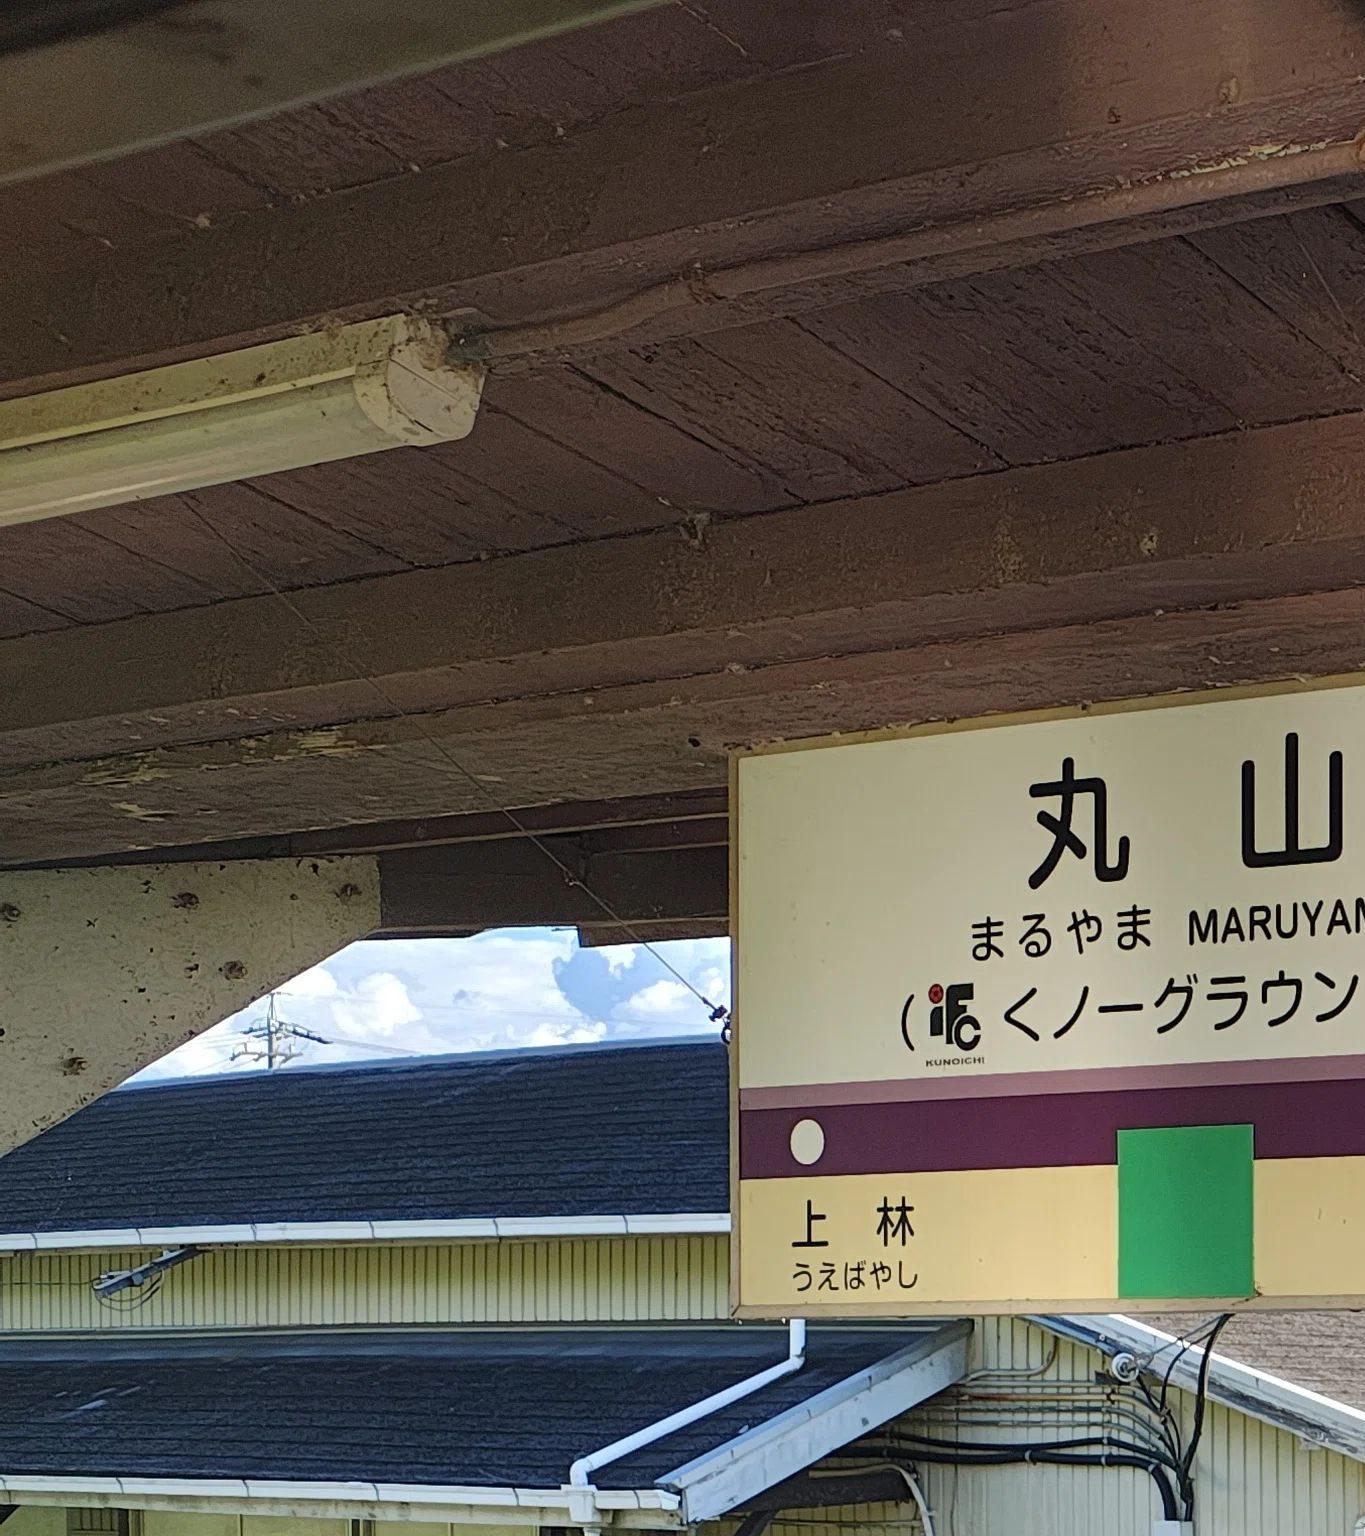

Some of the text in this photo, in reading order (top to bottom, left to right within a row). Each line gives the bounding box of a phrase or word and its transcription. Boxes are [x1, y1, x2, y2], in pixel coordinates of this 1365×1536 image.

[971, 904, 1152, 962] まるやま
[925, 1056, 986, 1068] KUNOICHI
[791, 1195, 915, 1248] 上林
[792, 1260, 918, 1292] うえばやし
